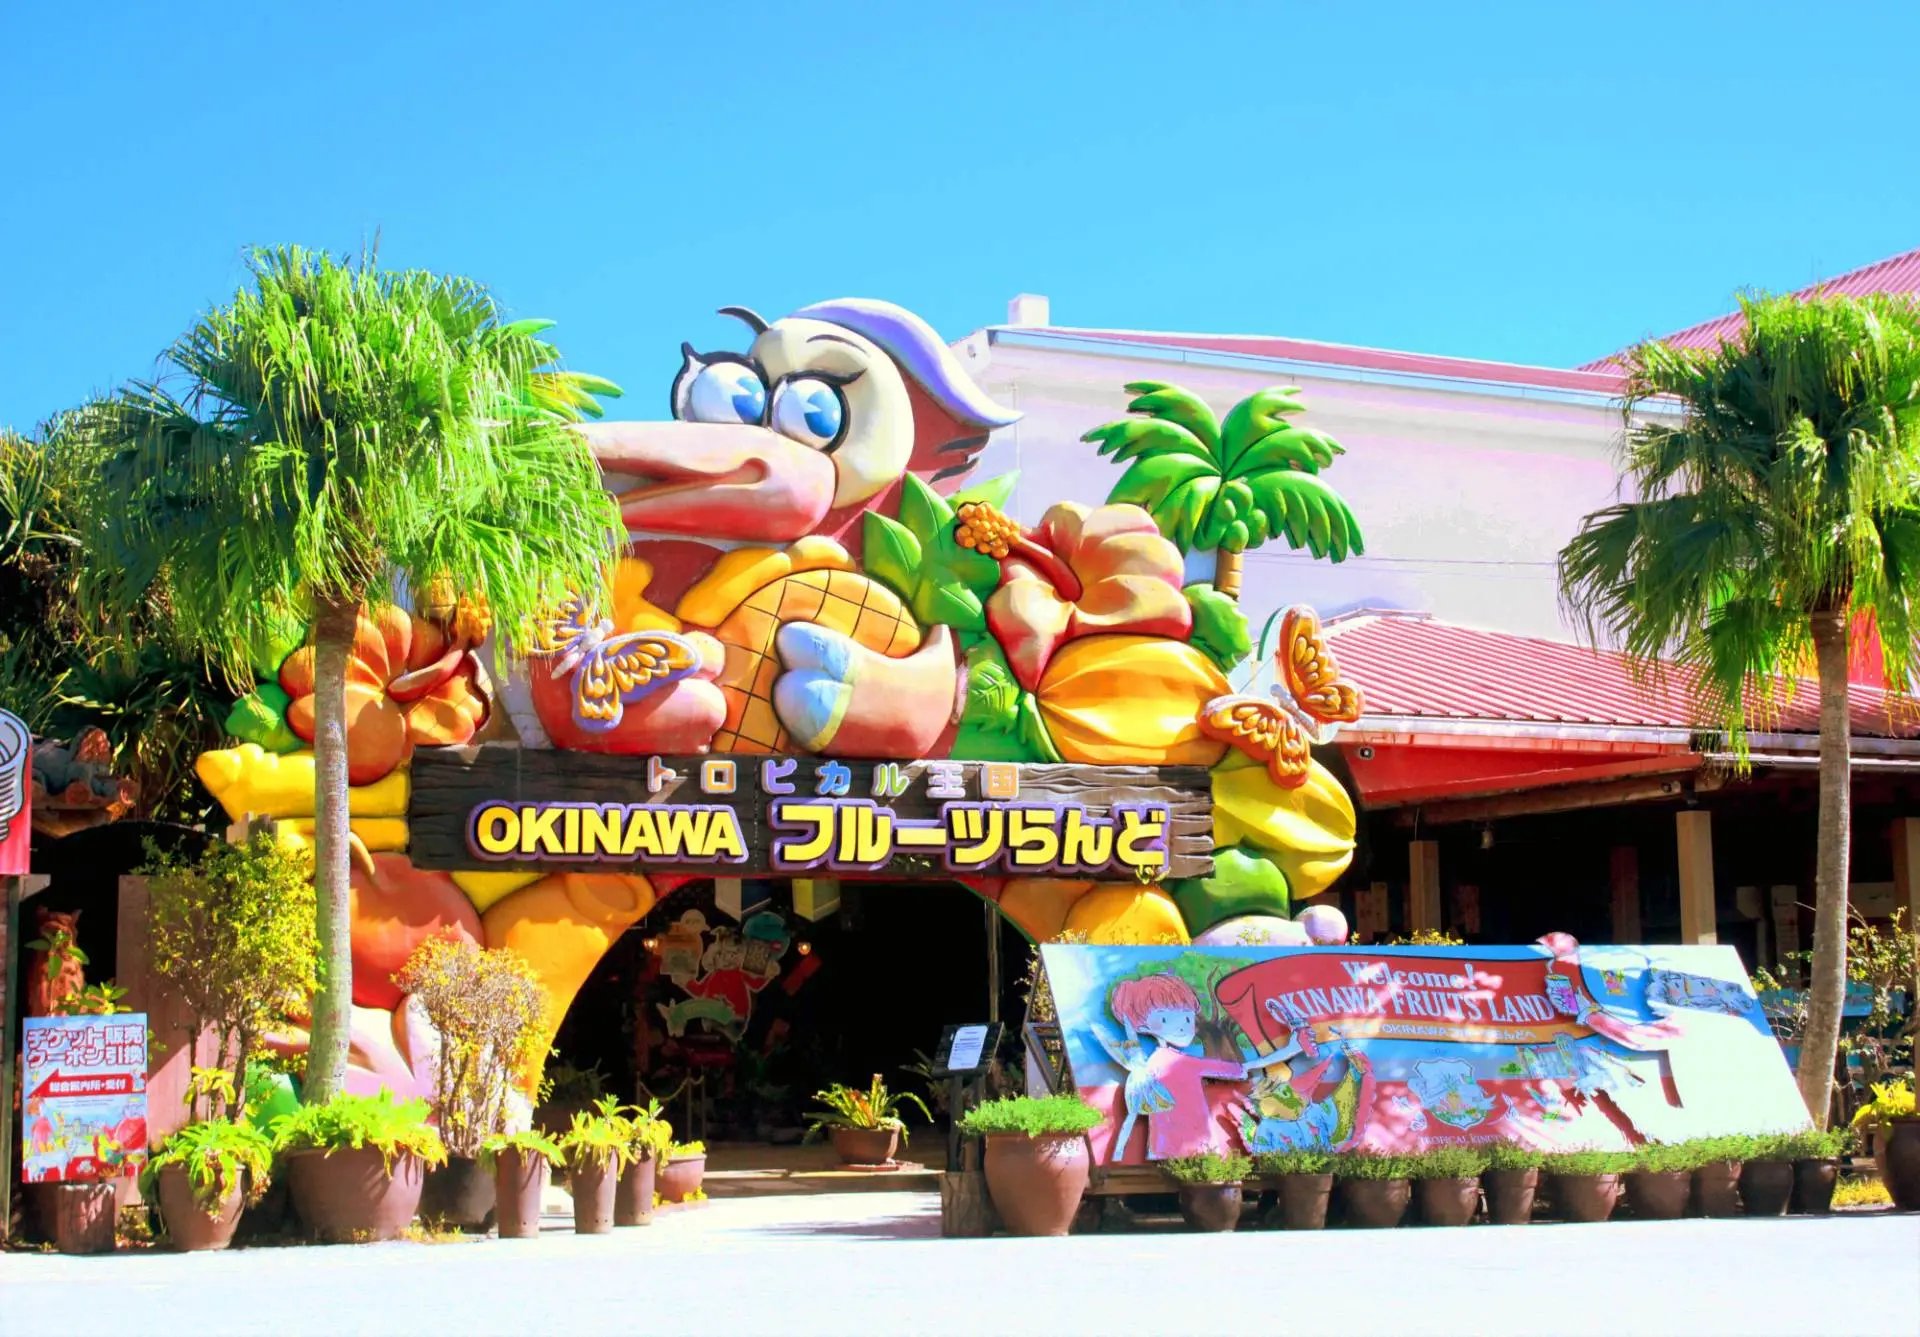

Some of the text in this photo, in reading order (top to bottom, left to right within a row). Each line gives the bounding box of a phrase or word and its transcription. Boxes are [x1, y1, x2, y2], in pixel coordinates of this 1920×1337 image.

[648, 756, 1019, 799] トロピカル王国
[475, 803, 1167, 867] OKINAWA フルーツらんど
[1340, 960, 1477, 991] Welcome!
[1265, 985, 1555, 1025] OKINAWA FRUITS LAND
[27, 1025, 144, 1049] チケット販売
[28, 1046, 144, 1069] クーポン引換
